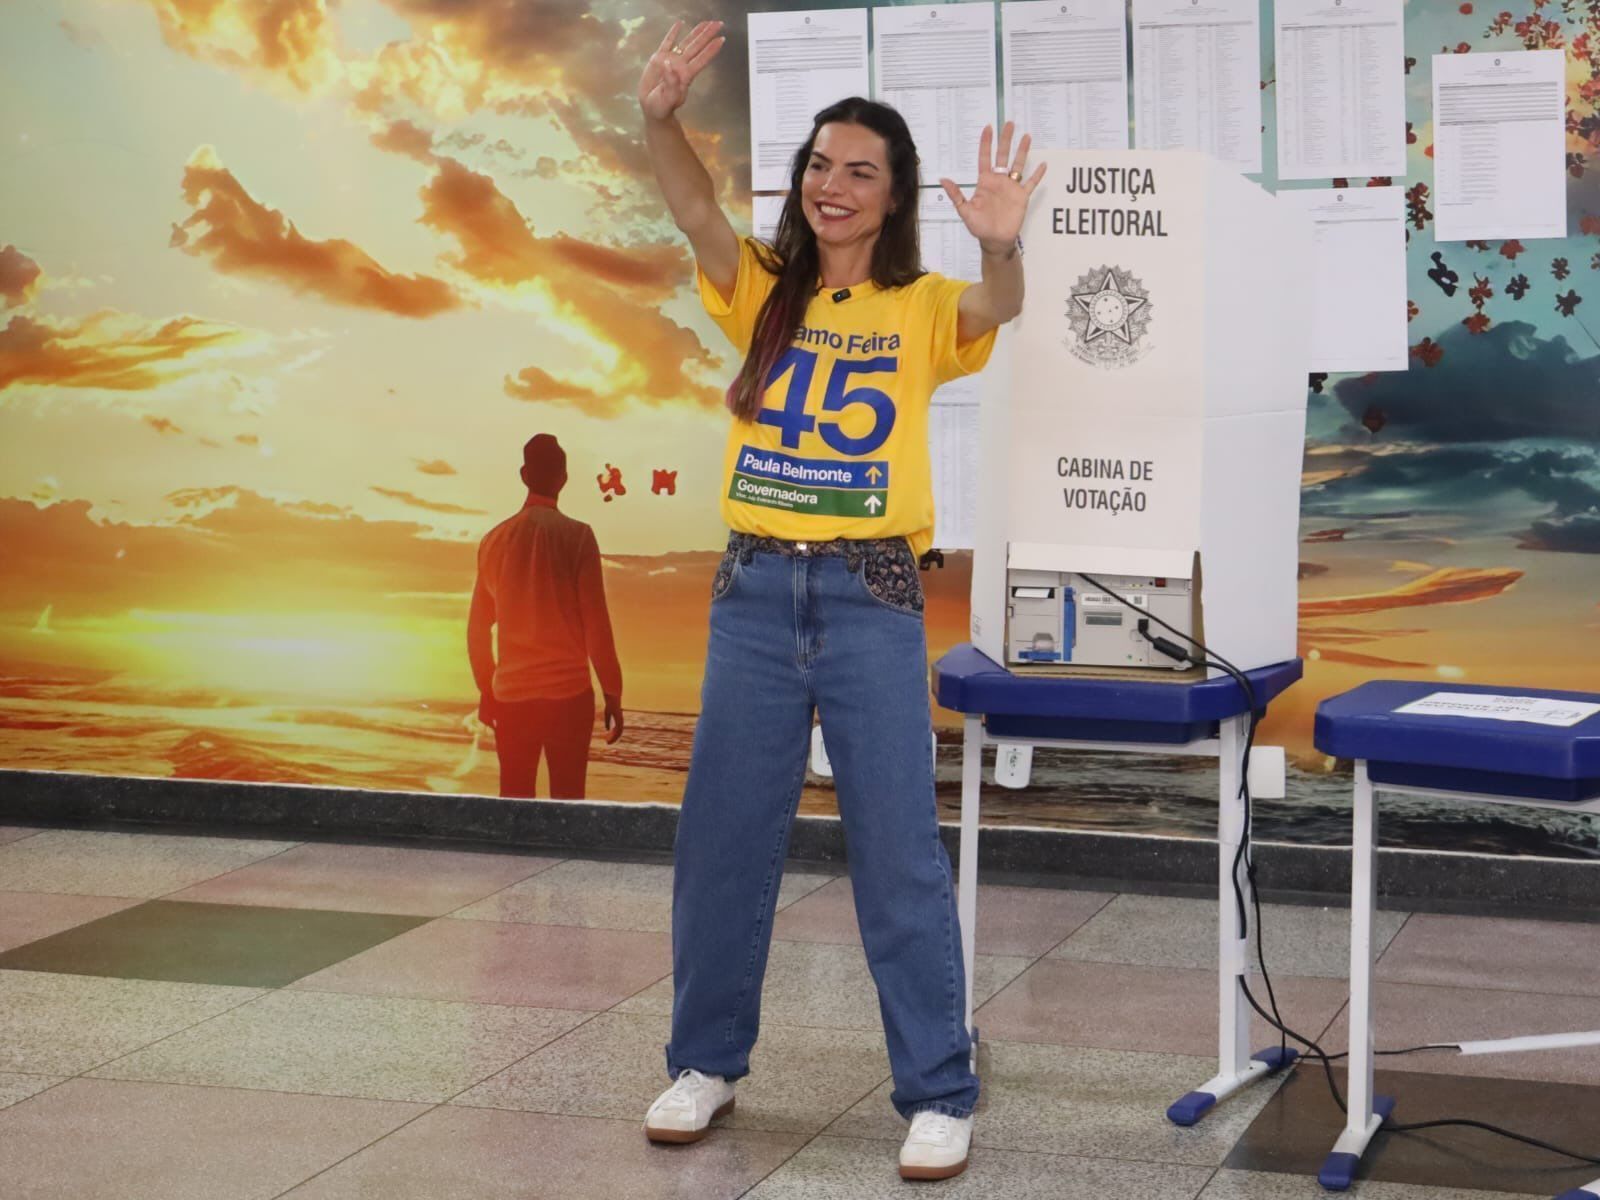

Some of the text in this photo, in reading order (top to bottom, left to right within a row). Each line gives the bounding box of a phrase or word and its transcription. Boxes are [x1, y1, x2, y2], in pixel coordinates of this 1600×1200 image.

[1066, 166, 1156, 202] JUSTIÇA
[1052, 208, 1168, 237] ELEITORAL
[795, 325, 901, 354] amo Feira
[756, 347, 898, 457] 45
[743, 453, 853, 484] Paula Belmonte
[1057, 456, 1153, 481] CABINA DE
[737, 478, 818, 505] Governadora
[1063, 487, 1147, 516] VOTAÇÃO
